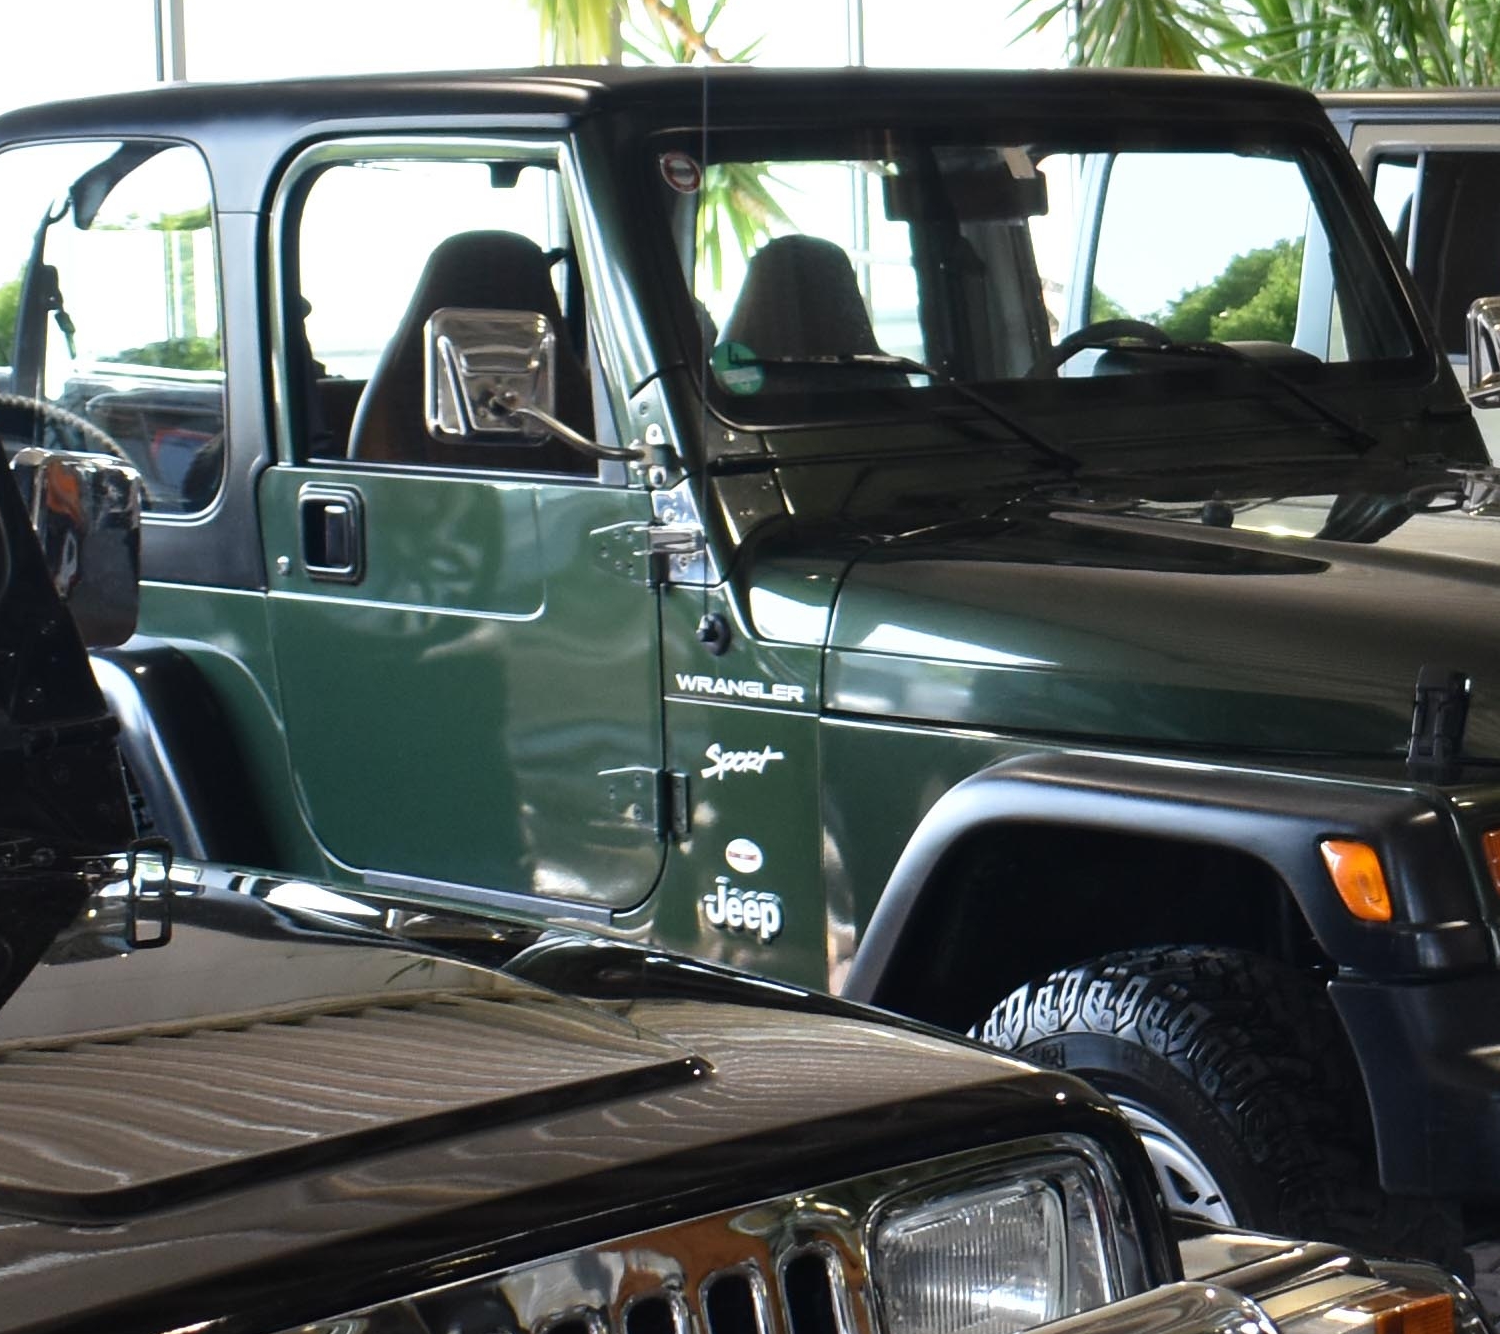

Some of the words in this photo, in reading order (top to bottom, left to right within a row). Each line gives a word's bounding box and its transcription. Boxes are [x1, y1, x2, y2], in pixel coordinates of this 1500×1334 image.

[675, 673, 805, 703] WRANGLER
[701, 742, 784, 781] Sport
[703, 875, 784, 944] Jeep
